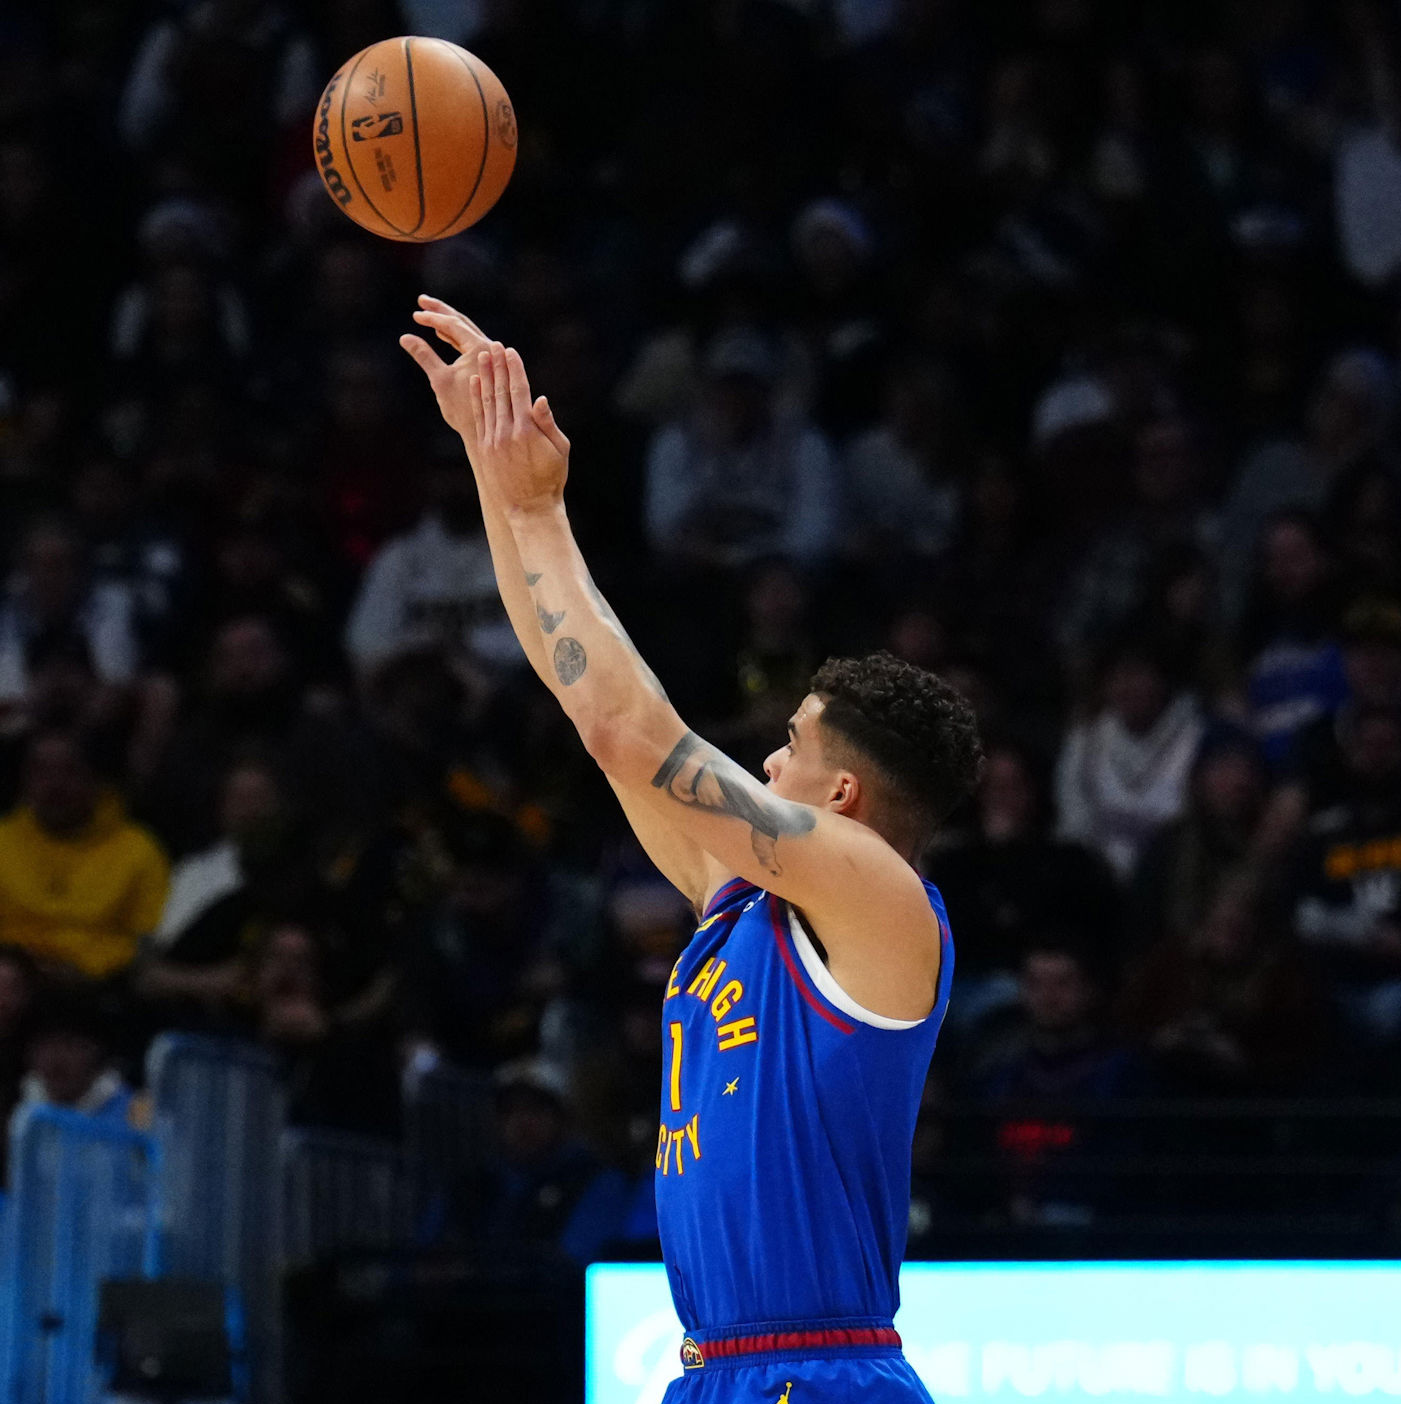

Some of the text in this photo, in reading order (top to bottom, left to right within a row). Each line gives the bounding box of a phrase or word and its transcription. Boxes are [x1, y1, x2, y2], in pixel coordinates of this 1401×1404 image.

[686, 956, 759, 1051] HIGH
[669, 1021, 682, 1112] 1
[655, 1113, 701, 1176] CITY
